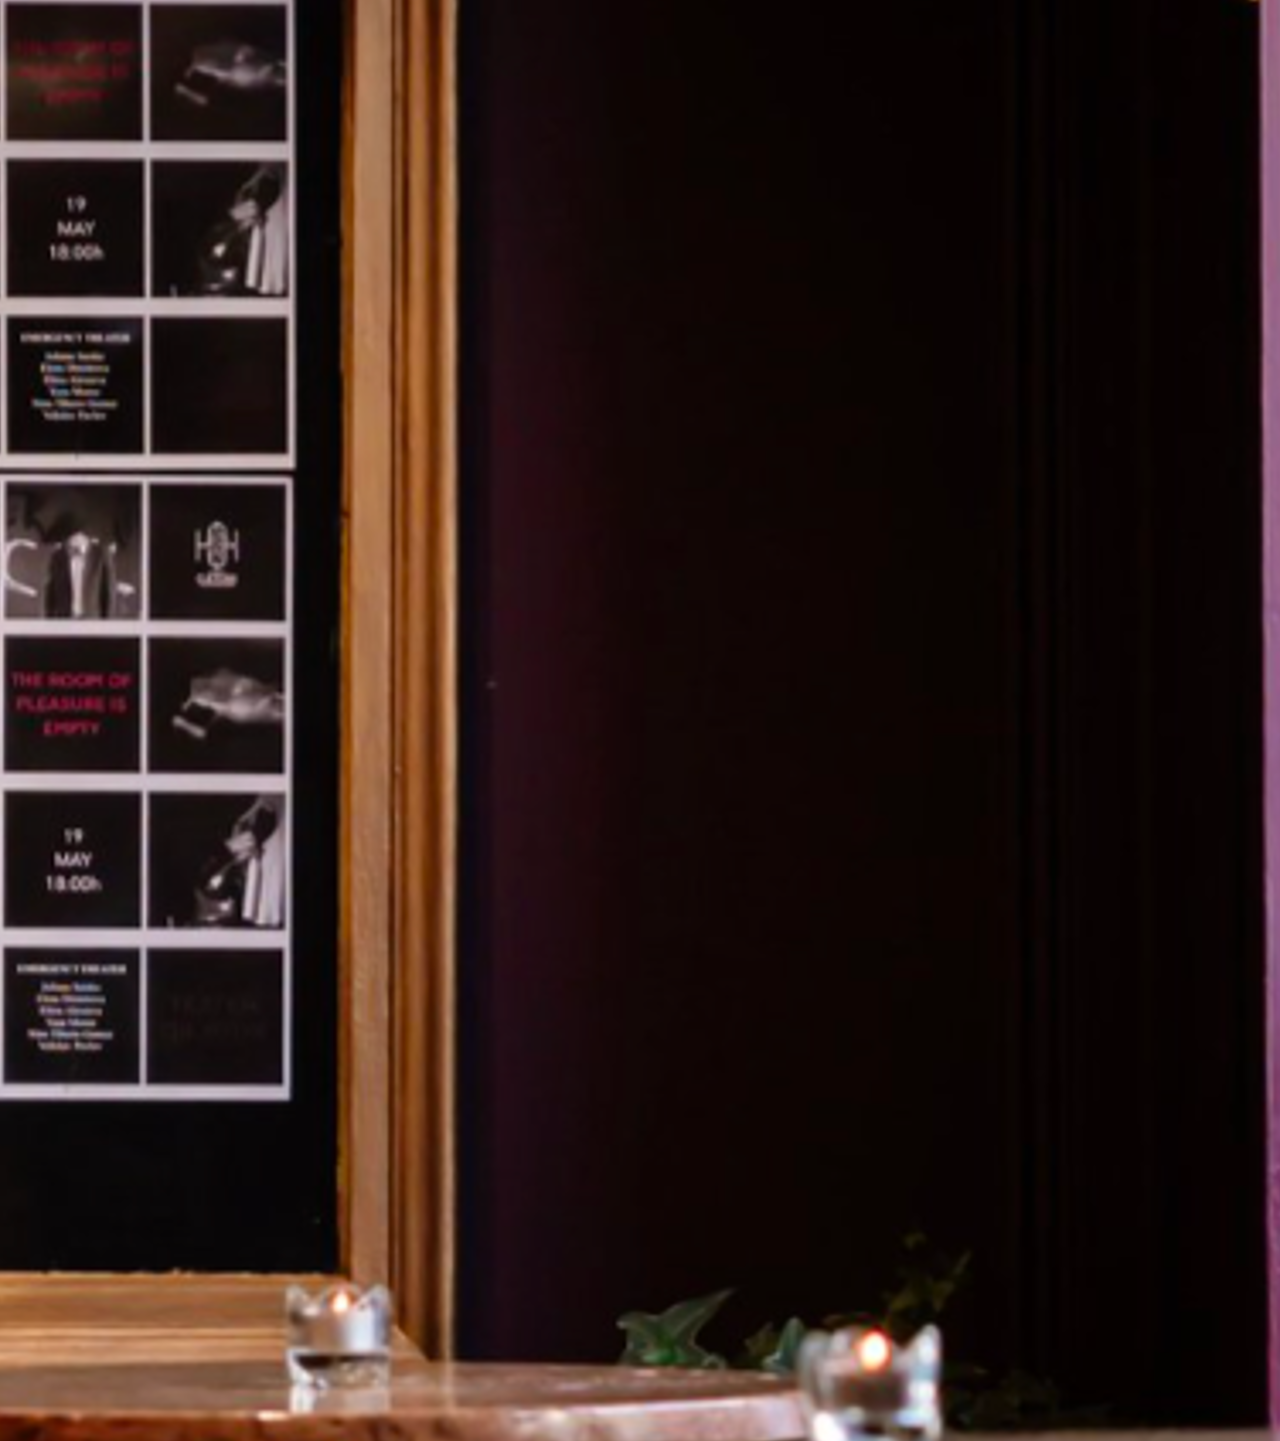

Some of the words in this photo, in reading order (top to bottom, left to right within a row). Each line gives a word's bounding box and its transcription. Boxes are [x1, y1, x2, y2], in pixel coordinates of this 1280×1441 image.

[56, 219, 97, 237] MAY
[12, 672, 44, 688] THE
[16, 695, 106, 713] PLEASURE
[53, 851, 93, 868] MAY
